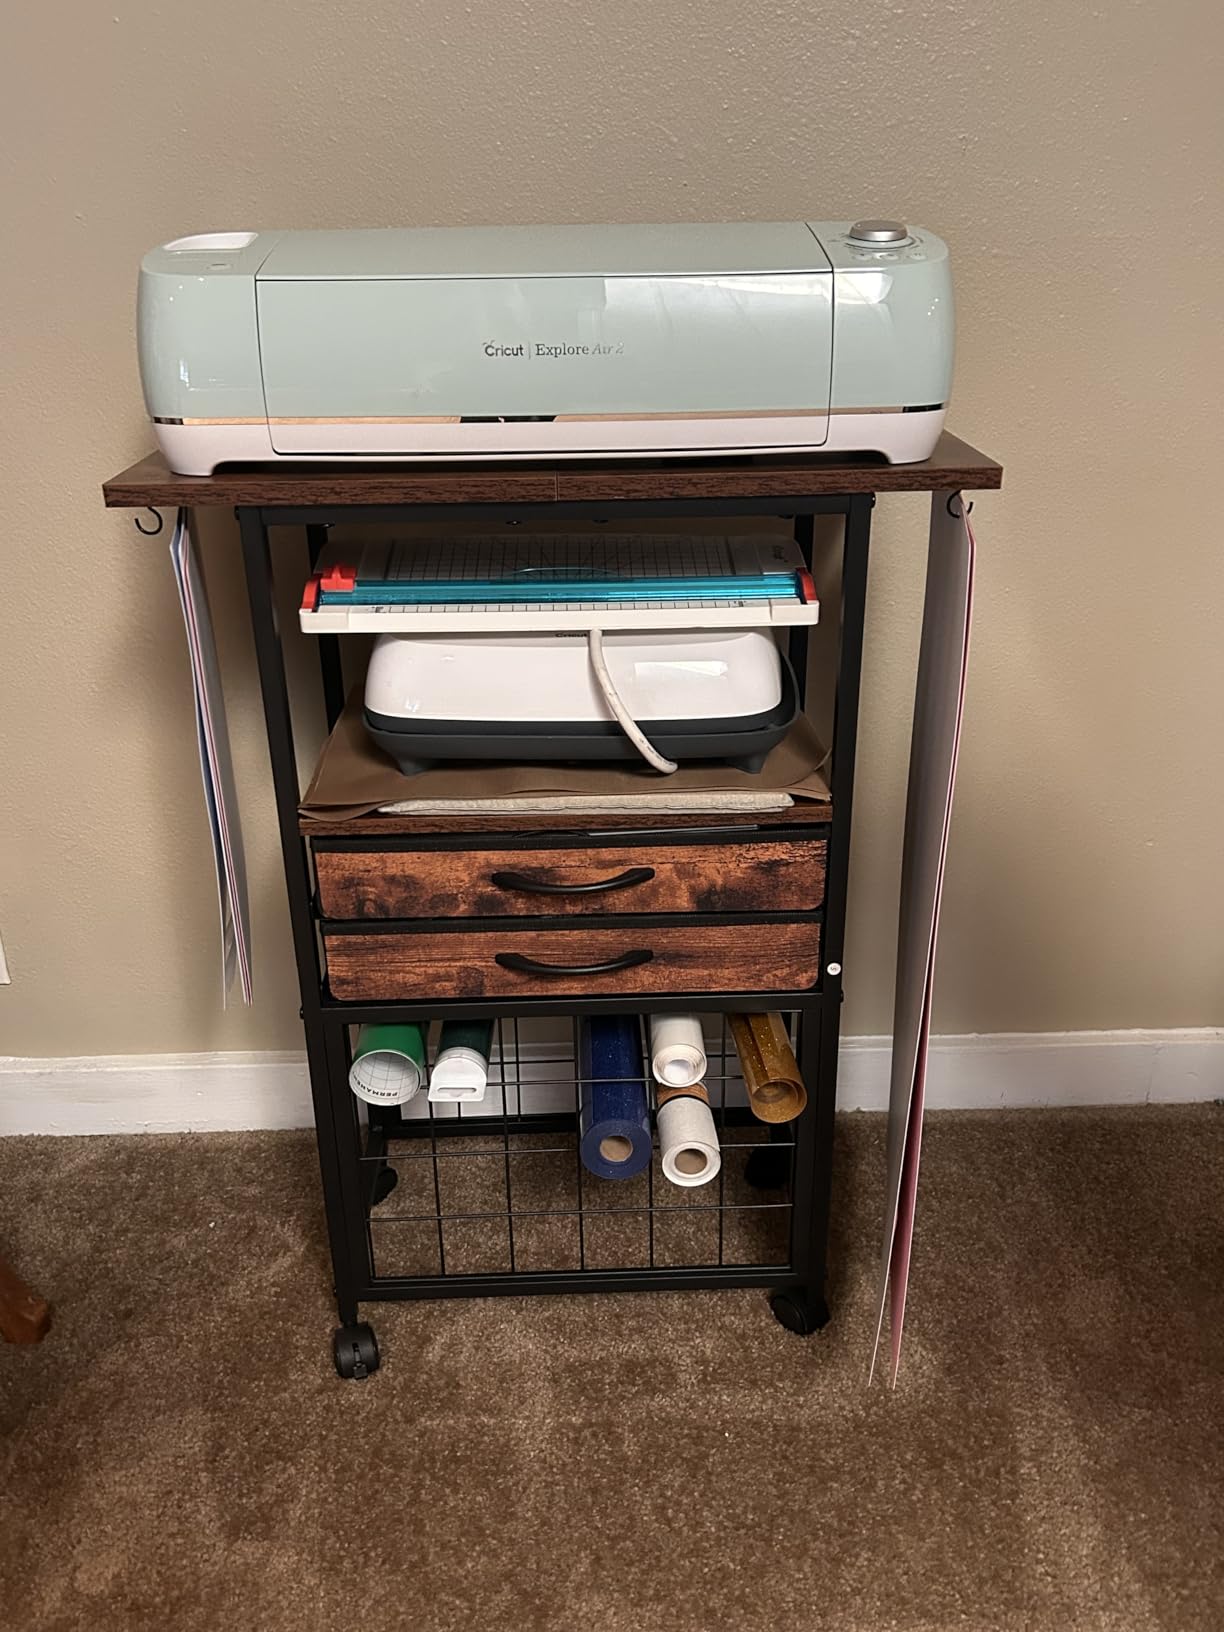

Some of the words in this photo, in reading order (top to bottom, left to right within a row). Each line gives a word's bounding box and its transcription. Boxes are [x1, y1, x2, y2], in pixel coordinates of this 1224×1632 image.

[483, 341, 524, 357] Cricut
[535, 342, 589, 358] Explore
[592, 343, 613, 355] Air
